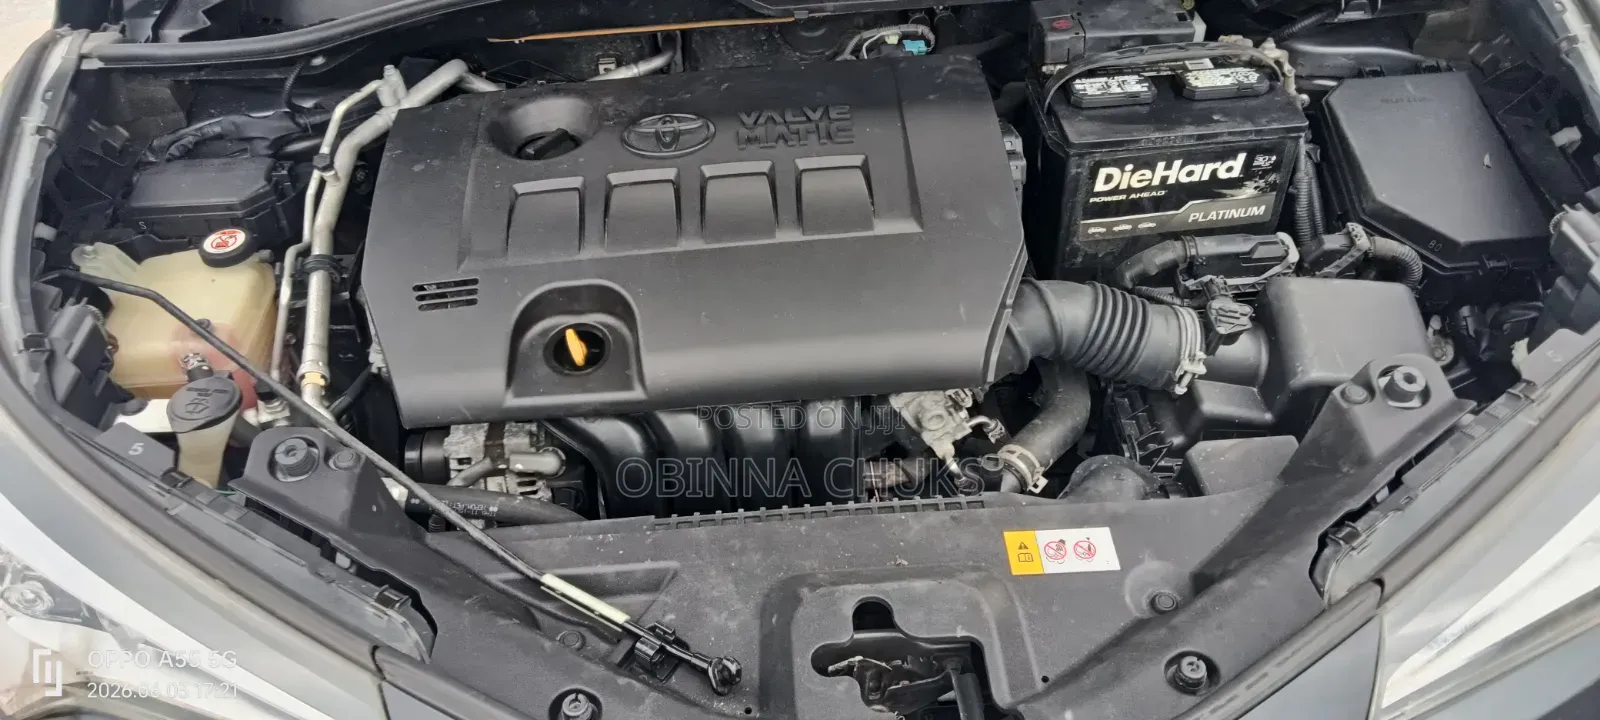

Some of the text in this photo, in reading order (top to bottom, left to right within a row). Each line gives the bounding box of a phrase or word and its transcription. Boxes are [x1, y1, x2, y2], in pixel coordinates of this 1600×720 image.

[737, 104, 851, 125] VALVE
[736, 121, 855, 150] MATIC
[1093, 153, 1248, 192] DieHard
[1089, 191, 1165, 203] POWER AHEAD
[1188, 205, 1266, 223] PLATINUM
[128, 442, 145, 456] 5
